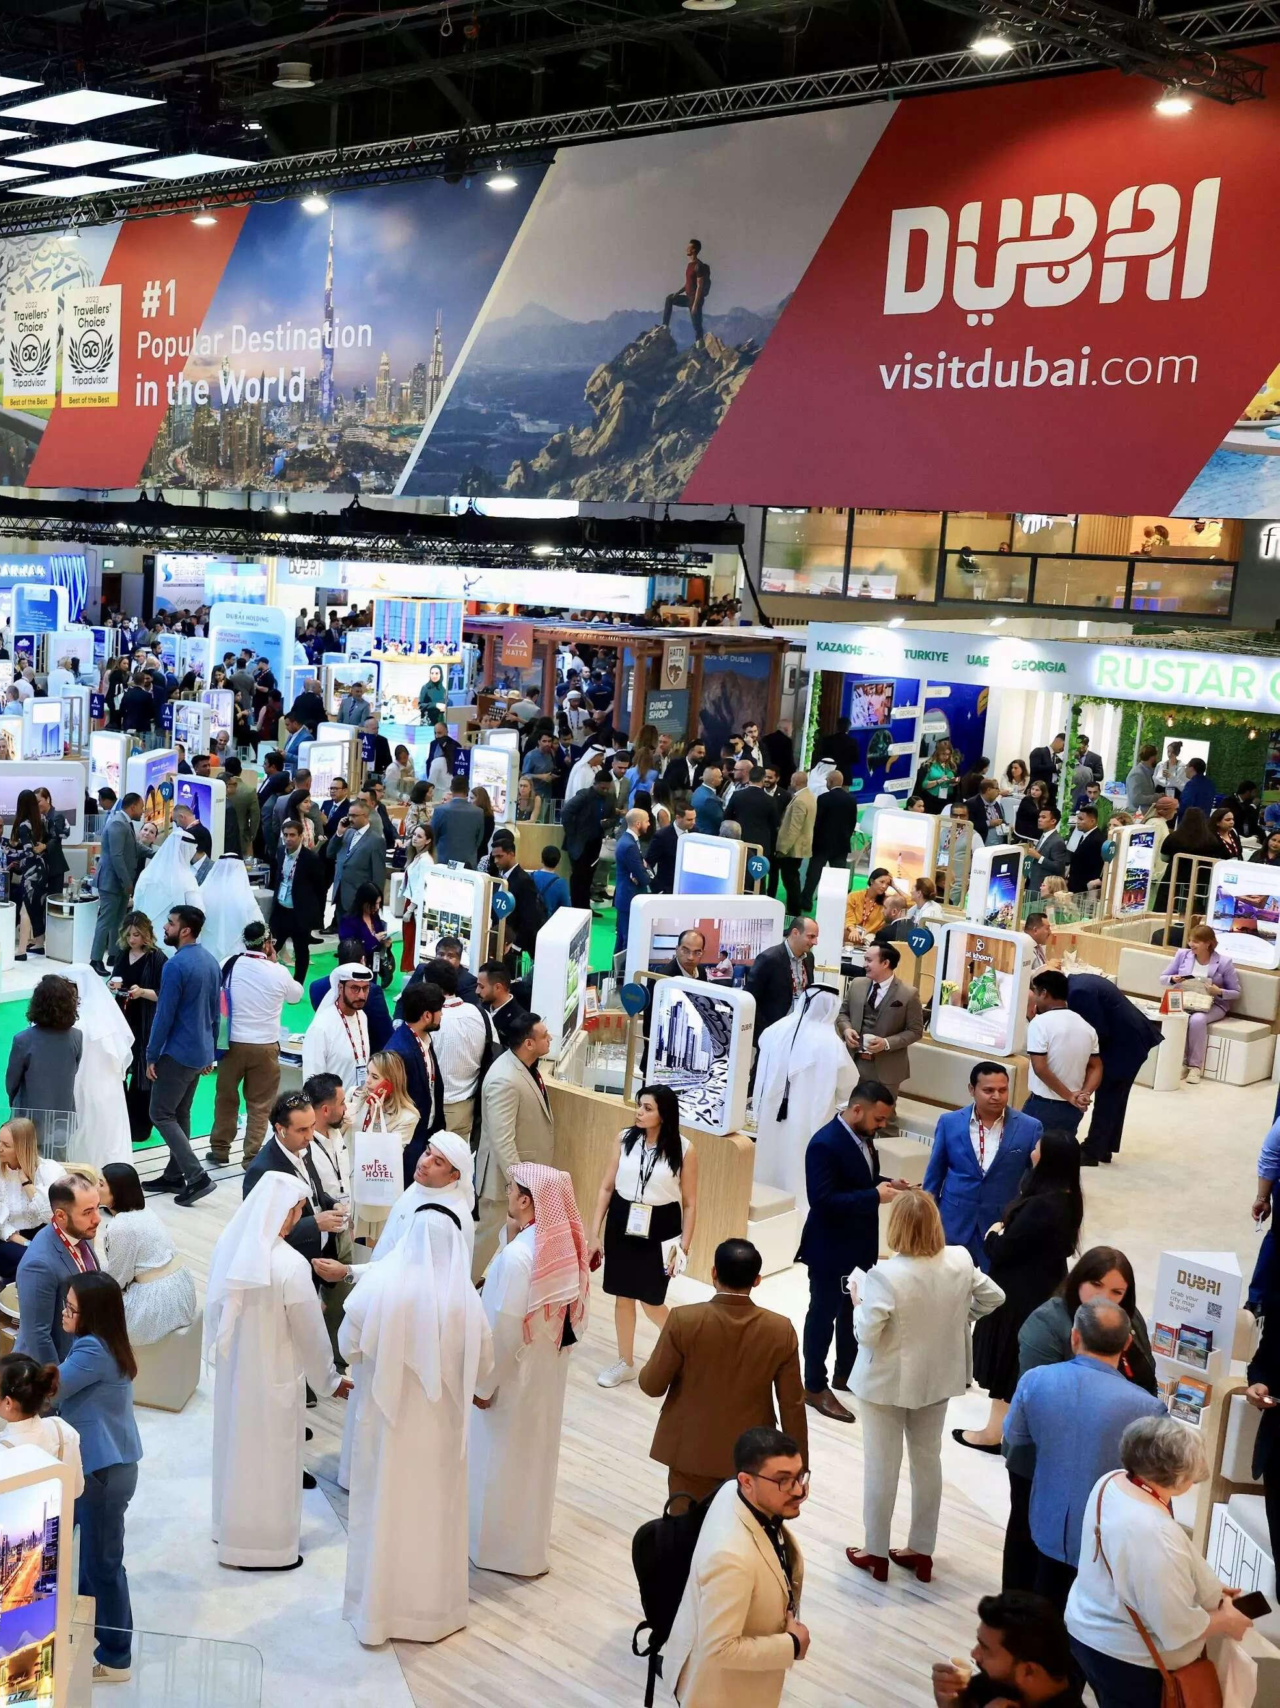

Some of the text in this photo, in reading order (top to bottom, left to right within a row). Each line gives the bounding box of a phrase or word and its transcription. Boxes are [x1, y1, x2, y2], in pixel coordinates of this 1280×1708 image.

[883, 177, 1221, 326] DUBAI
[85, 296, 100, 304] 2023
[141, 279, 176, 318] #1
[25, 301, 38, 309] 2022
[73, 303, 112, 317] Travellers'
[14, 308, 50, 321] Travellers'
[18, 321, 43, 333] Choice
[78, 317, 106, 328] Choice
[137, 318, 372, 364] Popular Destination
[879, 347, 1198, 390] visitdubai.com
[12, 378, 47, 389] Tripadvisor
[72, 375, 109, 387] Tripadvisor
[135, 366, 306, 407] in the World
[10, 398, 21, 406] Best
[21, 398, 27, 406] of
[36, 397, 48, 405] Best
[81, 396, 88, 404] of
[97, 395, 110, 403] Best
[245, 615, 269, 623] HOLDING
[505, 648, 528, 657] HATTA
[730, 655, 752, 664] DUBAI
[903, 647, 949, 662] TURKIYE
[966, 654, 990, 667] UAE
[1011, 659, 1067, 674] GEORGIA
[1097, 654, 1257, 700] RUSTAR
[649, 700, 667, 711] DINE
[648, 710, 669, 719] SHOP
[162, 787, 170, 796] 67
[750, 861, 763, 873] 75
[495, 899, 507, 911] 76
[911, 935, 926, 948] 77
[972, 951, 994, 963] khoory
[365, 1170, 394, 1179] HOTEL
[1177, 1269, 1221, 1297] DUBAI
[1170, 1288, 1199, 1304] Grab your
[1169, 1296, 1195, 1309] city map
[1176, 1302, 1192, 1313] guide
